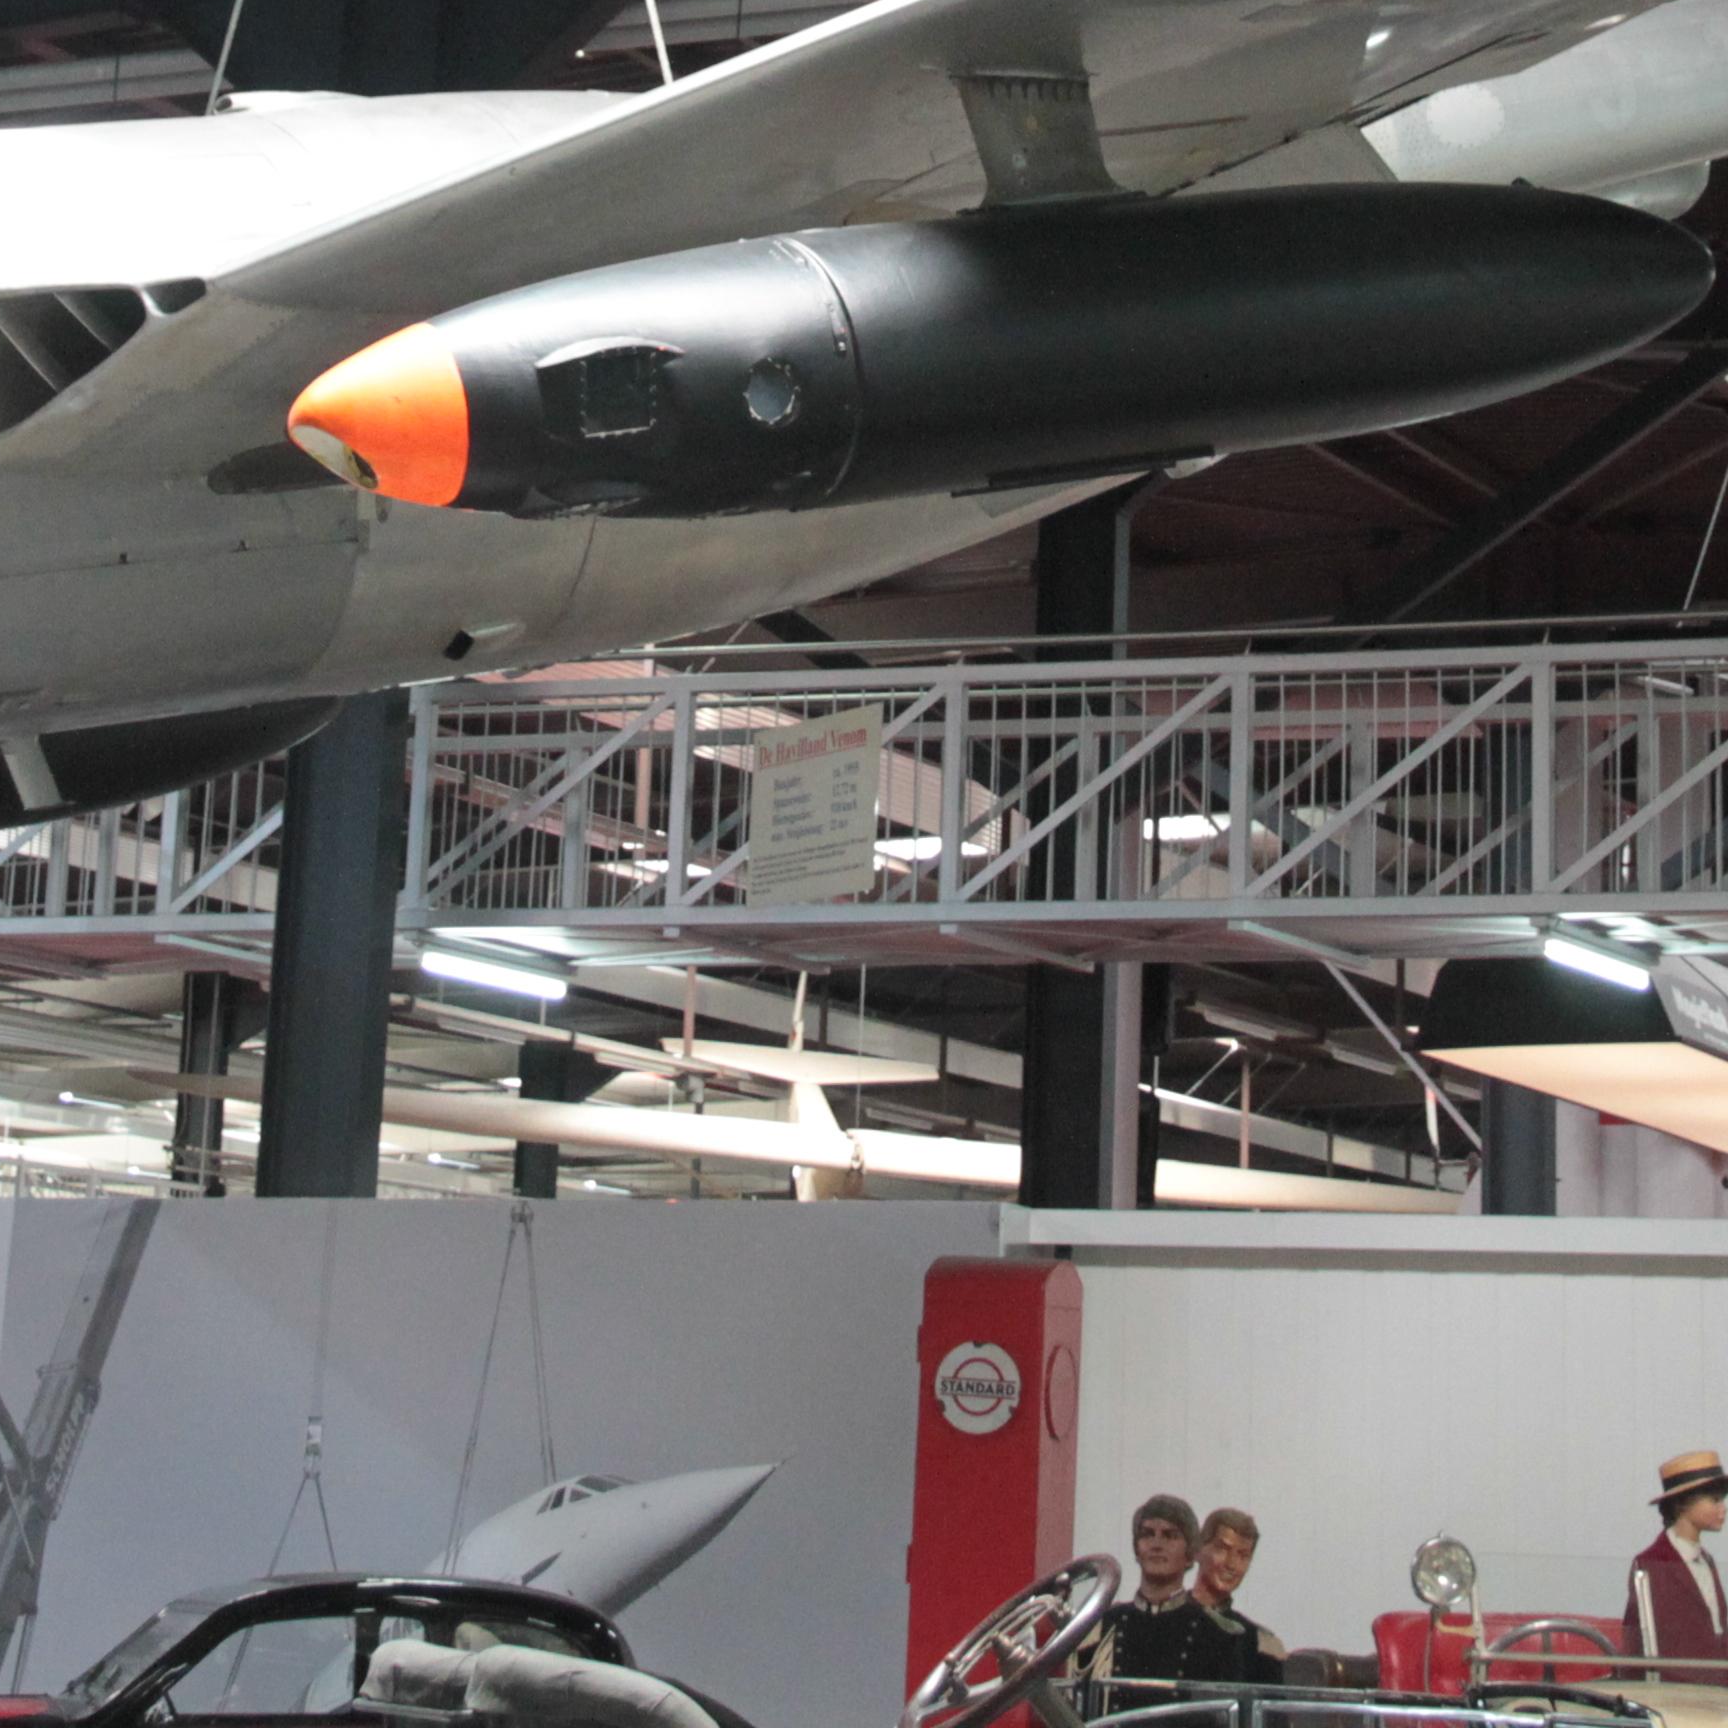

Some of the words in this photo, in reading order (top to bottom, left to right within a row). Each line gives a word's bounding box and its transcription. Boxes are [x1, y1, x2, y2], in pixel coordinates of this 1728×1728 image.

[759, 746, 772, 768] De
[776, 731, 827, 764] Havilland
[830, 728, 868, 748] Venom
[940, 1379, 1015, 1396] STANDARD
